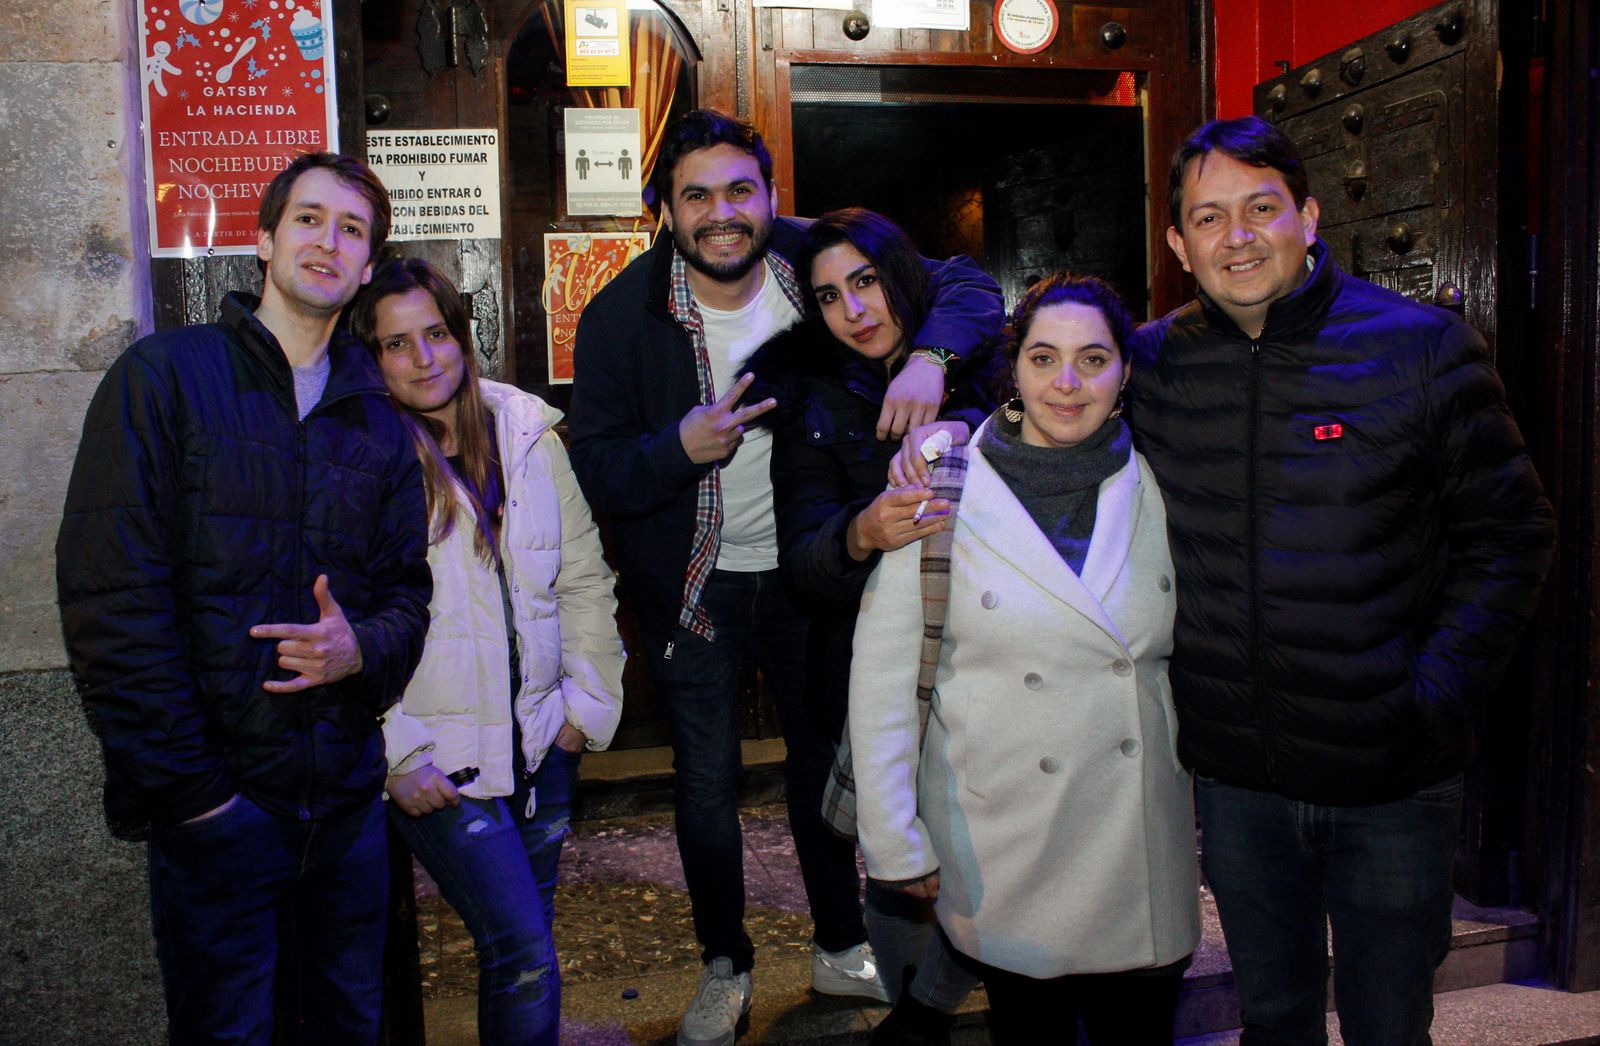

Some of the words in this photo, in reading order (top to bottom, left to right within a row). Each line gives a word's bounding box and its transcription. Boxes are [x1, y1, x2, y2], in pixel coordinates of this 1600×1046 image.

[203, 86, 268, 97] GATSBY
[187, 105, 206, 116] LA
[214, 104, 297, 116] HACIENDA
[159, 130, 259, 147] ENTRADA
[265, 129, 321, 145] LIBRE
[366, 136, 392, 147] ESTE
[395, 135, 496, 147] ESTABLECIMIENTO
[169, 156, 298, 173] NOCHEBUEN
[368, 154, 383, 165] TA
[386, 153, 446, 165] PROHIBIDO
[450, 153, 487, 163] FUMAR
[418, 170, 426, 181] Y
[178, 182, 271, 199] NOCHEV
[387, 188, 424, 200] HIBIDO
[427, 187, 471, 199] ENTRAR
[392, 206, 416, 217] CON
[419, 205, 466, 217] BEBIDAS
[468, 205, 489, 216] DEL
[203, 230, 233, 238] PRTIR
[389, 222, 475, 235] TABLECIMIENTO
